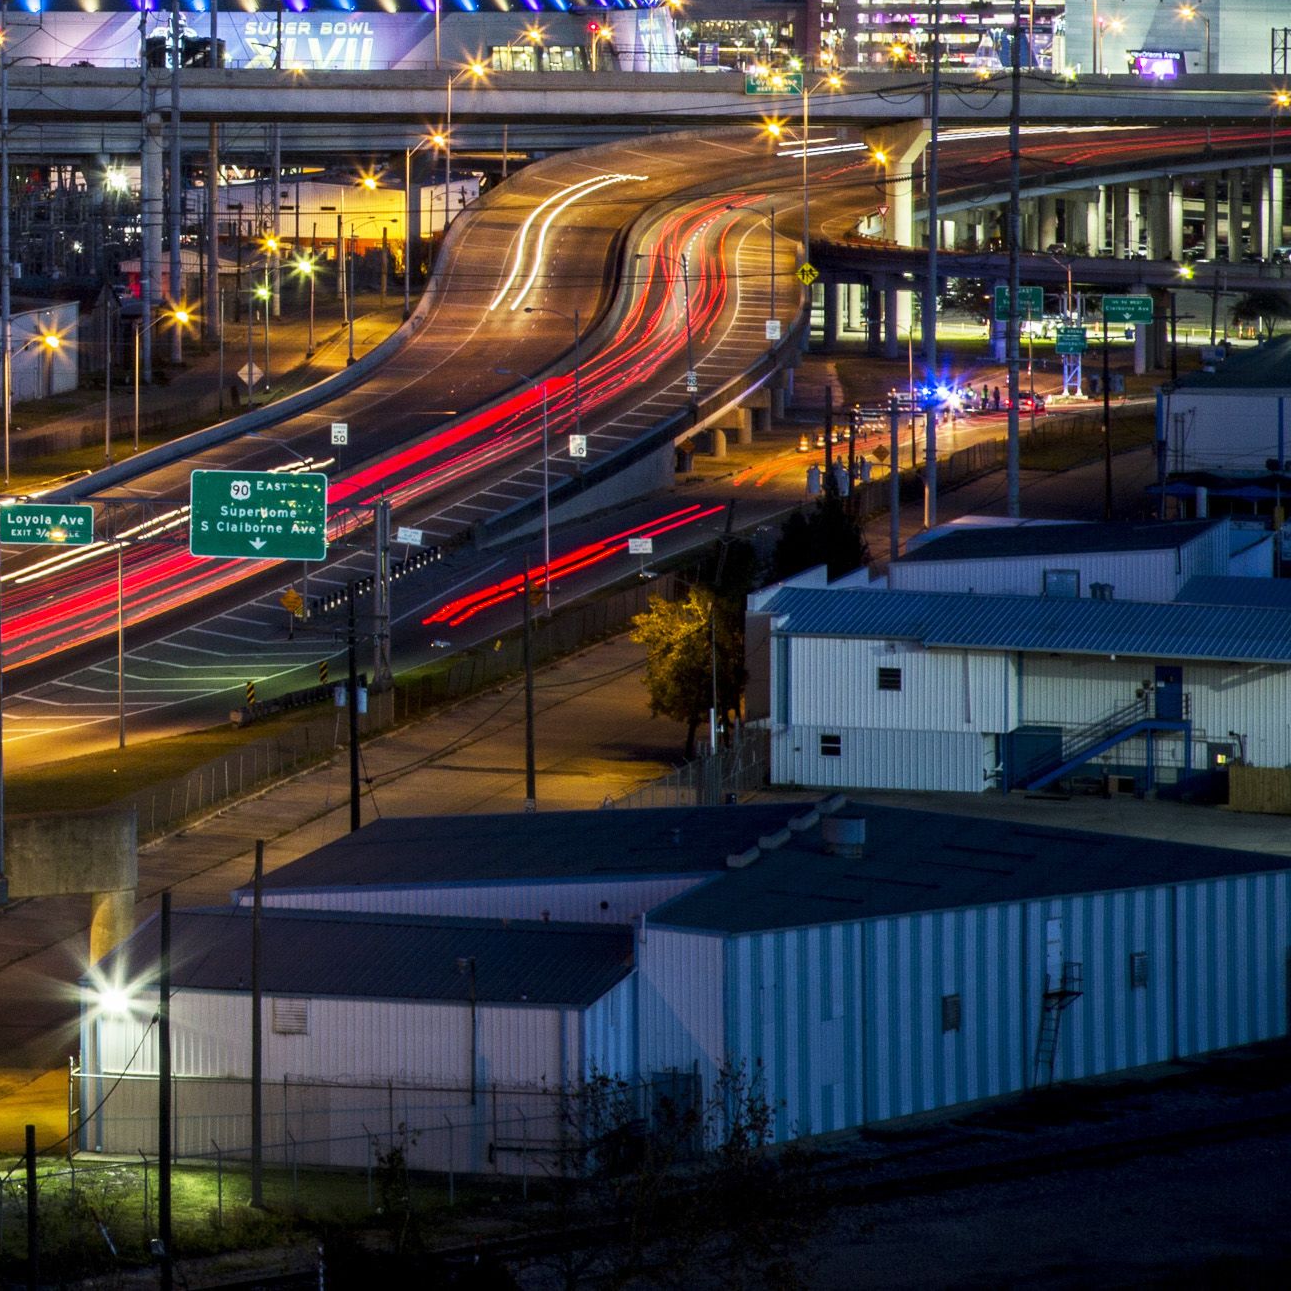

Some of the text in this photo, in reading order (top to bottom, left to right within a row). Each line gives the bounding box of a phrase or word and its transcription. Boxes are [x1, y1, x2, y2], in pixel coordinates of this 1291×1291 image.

[245, 21, 375, 35] SUPER BOWL
[232, 484, 249, 496] 90
[7, 513, 85, 526] Loyola Ave
[10, 529, 32, 537] EXIT
[201, 521, 317, 535] S Claiborne Ave
